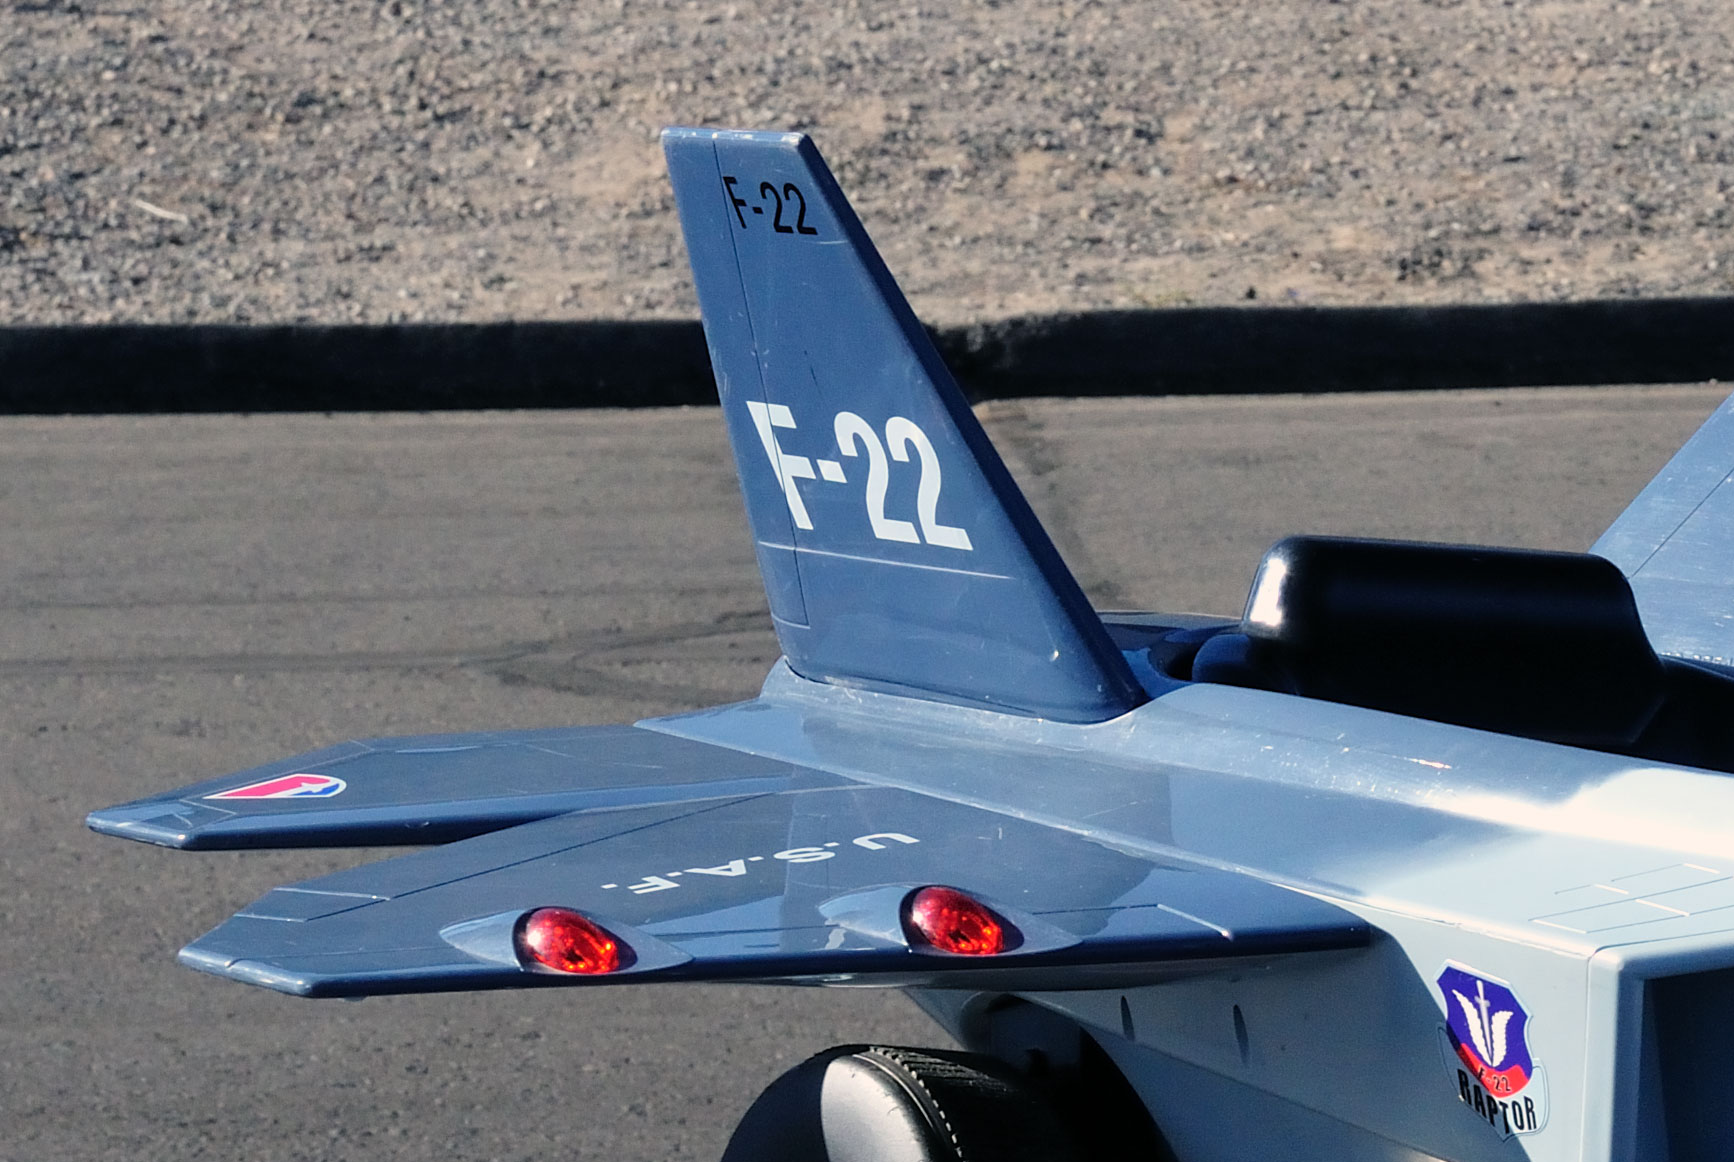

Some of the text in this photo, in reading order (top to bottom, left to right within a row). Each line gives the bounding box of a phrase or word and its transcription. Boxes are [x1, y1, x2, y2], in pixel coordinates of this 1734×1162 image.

[722, 176, 818, 235] F-22
[746, 401, 973, 550] F-22
[601, 833, 920, 894] U.S.A.F.
[1457, 1069, 1537, 1134] RAPTOR
[1478, 1067, 1511, 1092] F-22
